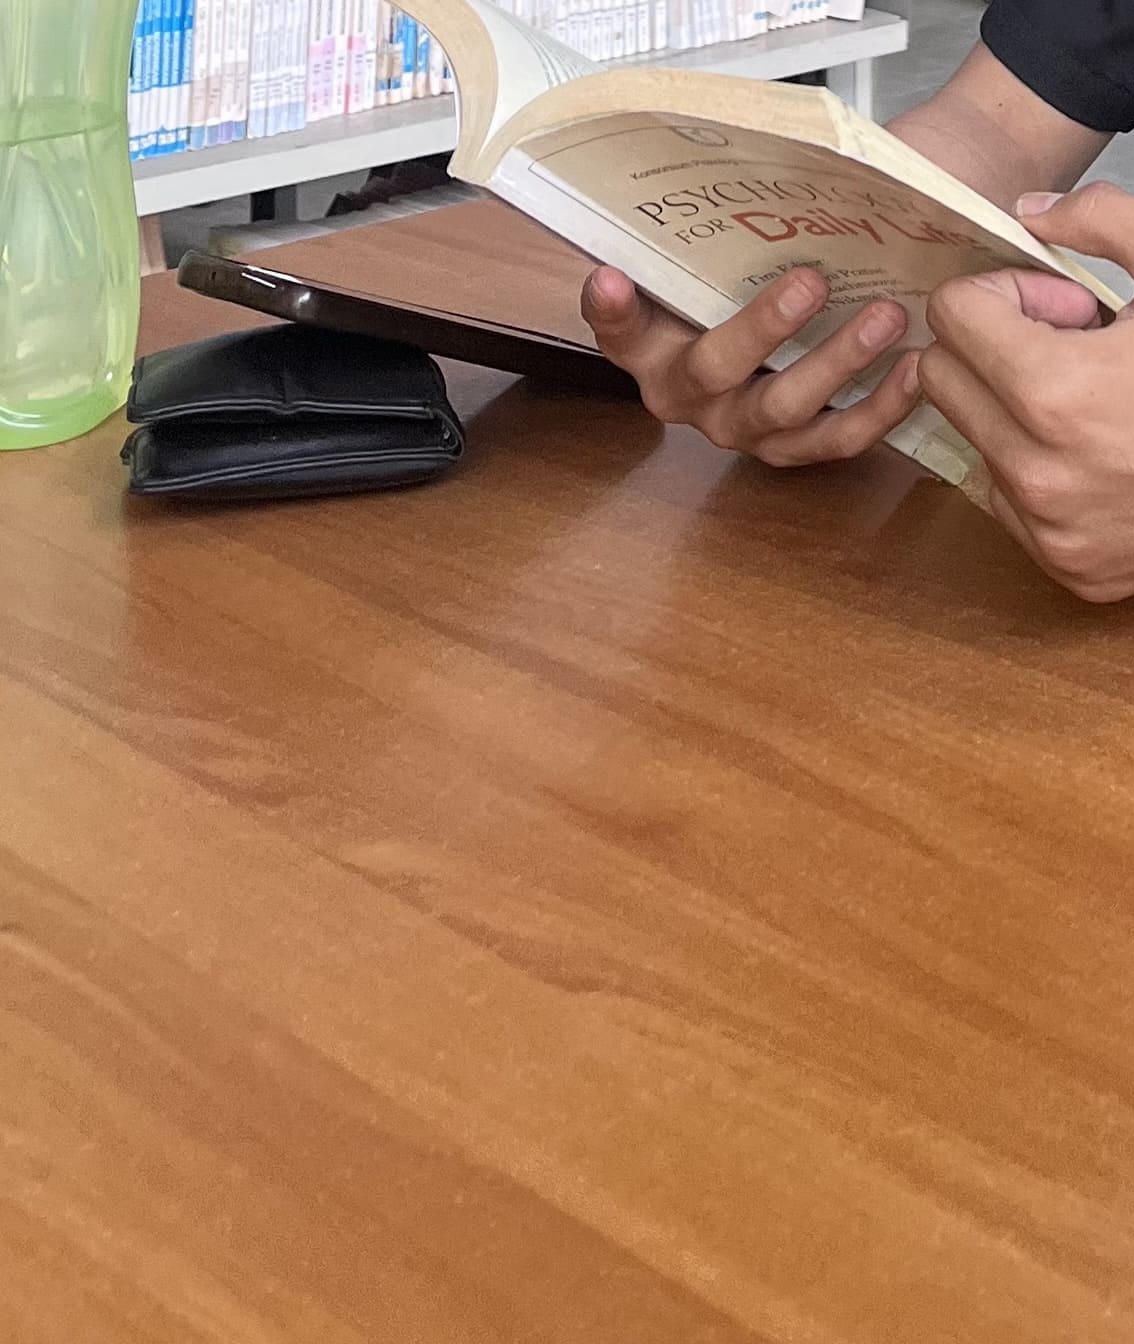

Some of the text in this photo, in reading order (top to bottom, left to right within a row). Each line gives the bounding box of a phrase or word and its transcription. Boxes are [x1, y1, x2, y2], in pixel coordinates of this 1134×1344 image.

[674, 218, 735, 245] FOR
[730, 207, 885, 245] Daily
[742, 269, 778, 287] Tim
